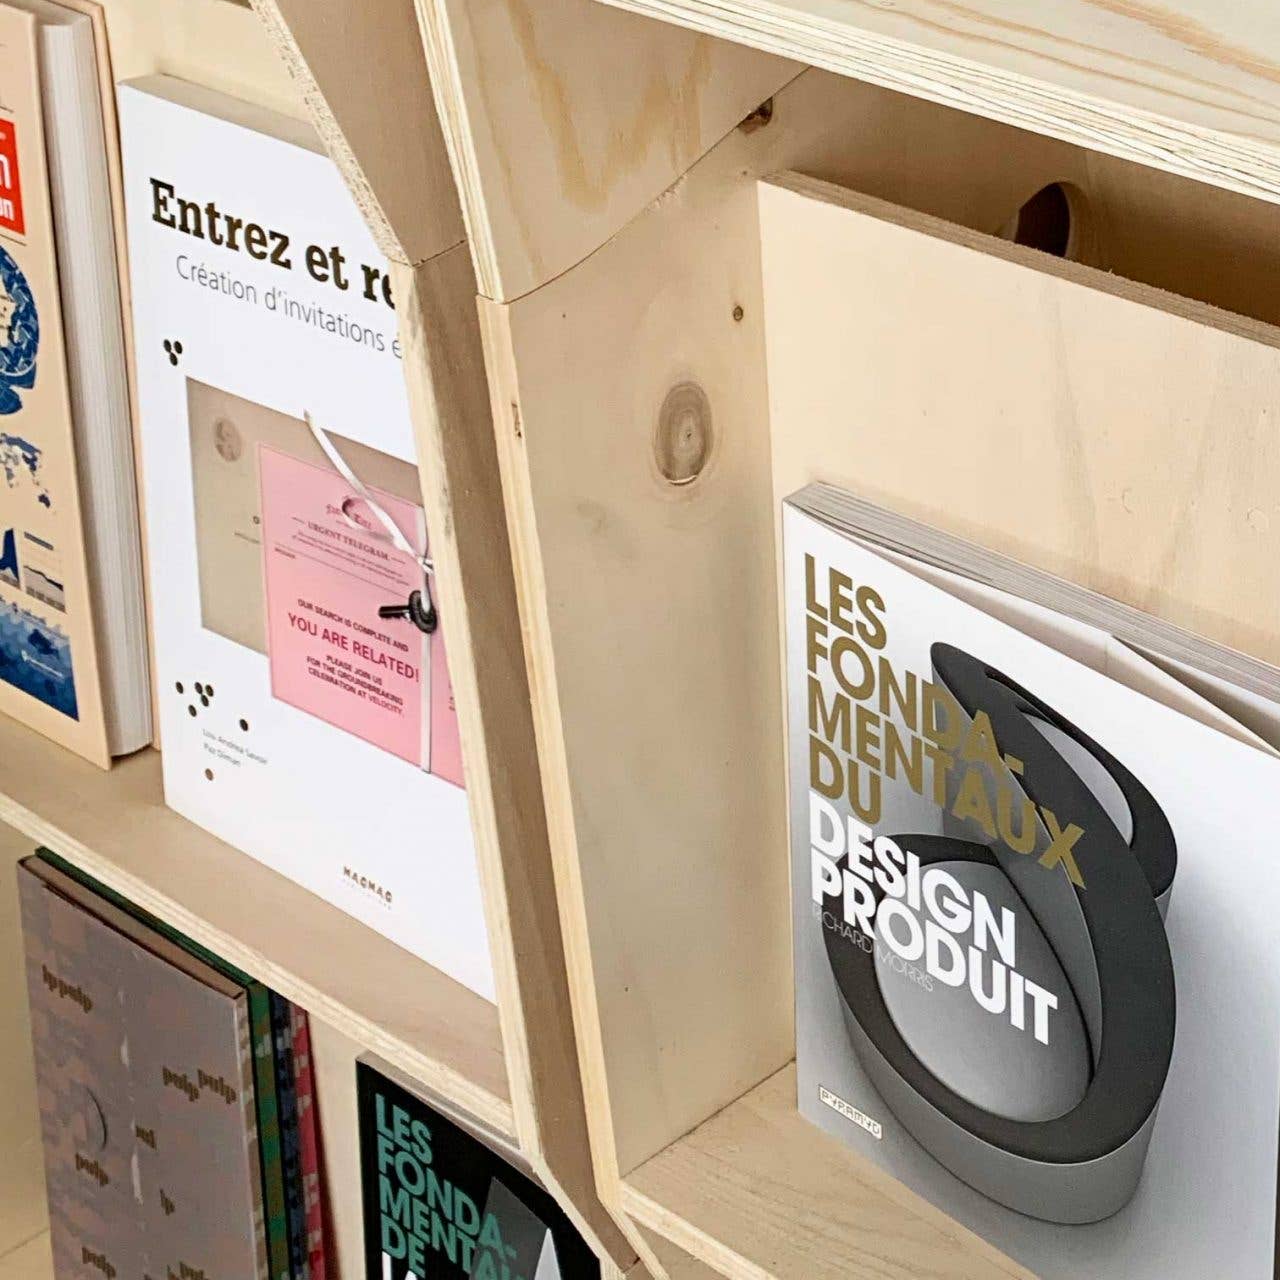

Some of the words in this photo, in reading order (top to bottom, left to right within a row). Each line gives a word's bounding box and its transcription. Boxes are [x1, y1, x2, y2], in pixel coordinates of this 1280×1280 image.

[150, 177, 292, 270] Entrez
[305, 245, 349, 291] et
[176, 255, 257, 304] Création
[308, 521, 343, 545] URGENT
[344, 533, 389, 561] TELEGRAM
[297, 598, 313, 608] OUR
[314, 604, 343, 624] SEARCH
[352, 622, 391, 645] COMPLETE
[392, 639, 409, 652] AND
[805, 553, 887, 650] LES
[288, 612, 318, 636] YOU
[322, 628, 349, 651] ARE
[352, 641, 420, 682] RELATED!
[306, 655, 321, 668] FOR
[323, 661, 336, 675] THE
[337, 669, 404, 706] GROUNDBREAKING
[308, 667, 356, 695] CELEBRATION
[326, 655, 352, 672] PLEASE
[354, 665, 371, 680] JOIN
[806, 614, 1024, 776] FONDA-
[807, 674, 1086, 890] MENTAUX
[809, 733, 882, 826] DU
[809, 790, 1016, 969] DESIGN
[811, 847, 1058, 1046] PRODUIT
[163, 1066, 199, 1102] pulp
[197, 1068, 237, 1104] pulp
[375, 1093, 433, 1165] LES
[378, 1133, 518, 1261] FONDA-
[380, 1213, 426, 1279] DE
